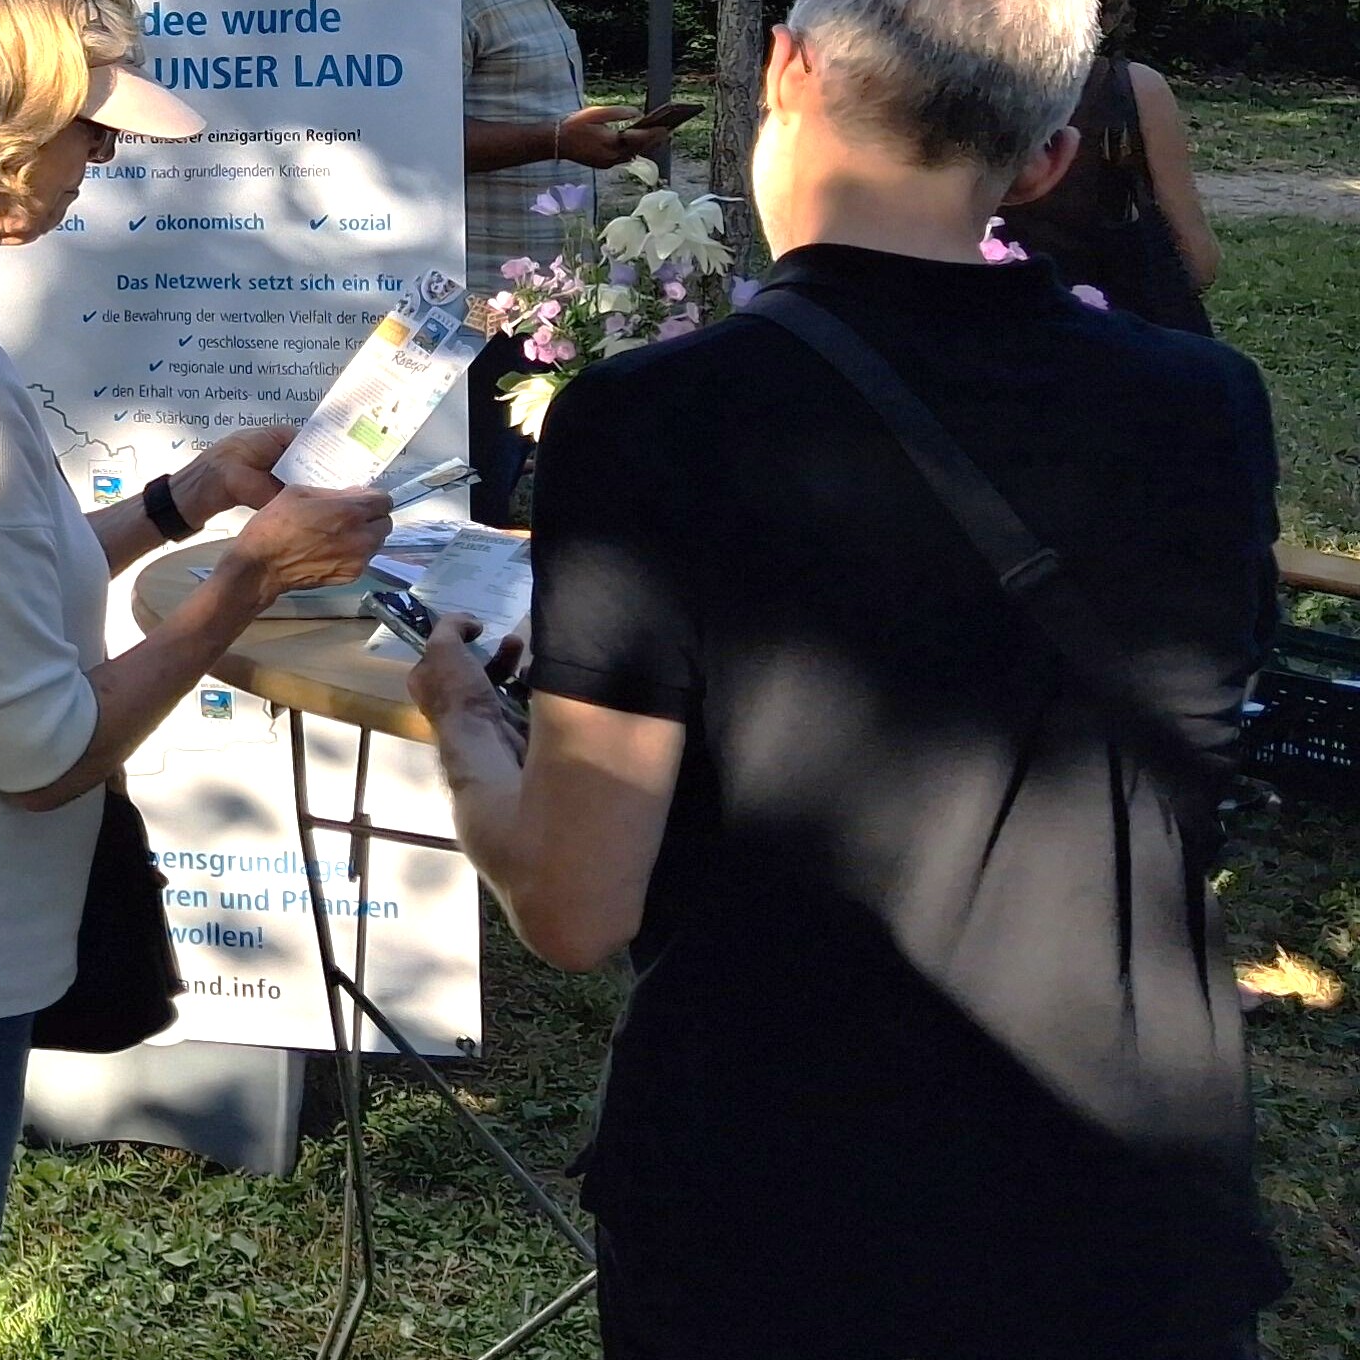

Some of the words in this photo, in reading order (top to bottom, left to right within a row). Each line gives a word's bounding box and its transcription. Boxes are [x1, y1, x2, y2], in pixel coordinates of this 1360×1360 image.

[142, 1, 207, 37] dee
[154, 55, 280, 90] UNSER
[294, 54, 404, 88] LAND
[208, 129, 300, 145] einzigartigen
[306, 128, 362, 145] Region!
[106, 166, 146, 179] LAND
[151, 167, 180, 179] nach
[184, 164, 274, 181] grundlegenden
[279, 165, 331, 178] Kriterien
[56, 215, 85, 231] sch
[156, 213, 265, 231] ökonomisch
[338, 213, 392, 232] sozial
[117, 275, 148, 290] Das
[155, 273, 241, 290] Netzwerk
[248, 275, 293, 290] setzt
[300, 274, 335, 291] sich
[342, 275, 370, 291] ein
[377, 273, 403, 291] für
[102, 309, 120, 323] die
[124, 309, 192, 326] Bewahrung
[196, 309, 215, 323] der
[220, 309, 284, 323] wertvollen
[289, 309, 332, 324] Vielfalt
[336, 310, 356, 324] der
[198, 336, 279, 351] geschlossene
[283, 338, 341, 352] regionale
[169, 362, 224, 376] regionale
[229, 362, 252, 375] und
[112, 386, 134, 399] den
[139, 385, 173, 399] Erhalt
[179, 388, 200, 400] von
[205, 386, 252, 400] Arbeits-
[257, 386, 280, 401] und
[133, 409, 151, 424] die
[156, 410, 210, 428] Stärkung
[214, 412, 234, 426] der
[149, 851, 356, 883] ensgrundlge
[165, 889, 208, 909] ren
[220, 888, 270, 912] und
[282, 890, 400, 919] Pfanzen
[168, 921, 264, 949] wollen!
[180, 975, 281, 1000] and.info
